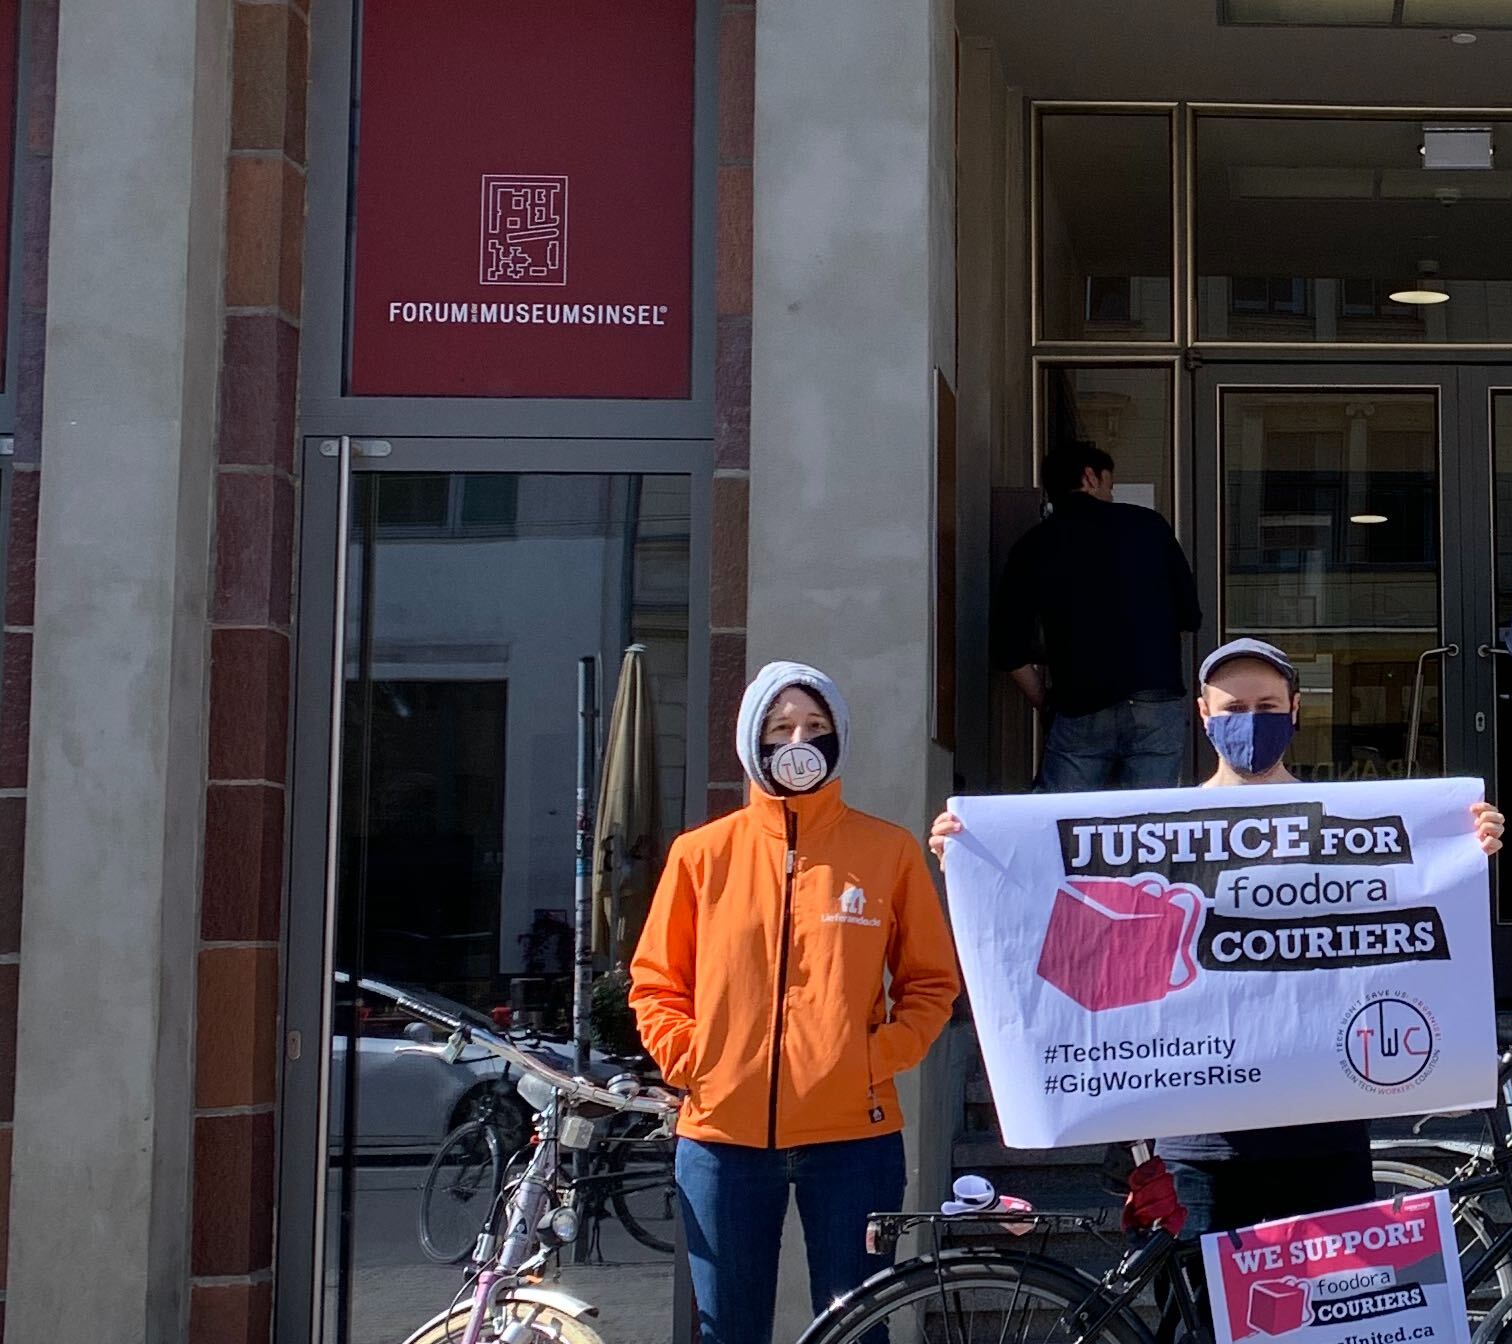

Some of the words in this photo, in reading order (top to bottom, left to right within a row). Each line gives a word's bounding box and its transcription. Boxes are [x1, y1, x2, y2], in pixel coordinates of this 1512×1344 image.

[389, 302, 468, 323] FORUM
[1071, 816, 1309, 868] JUSTICE
[1320, 827, 1401, 856] FOR
[1227, 872, 1388, 909] foodora
[1211, 920, 1435, 963] COURIERS
[1044, 1035, 1236, 1065] #TechSolidarity
[1356, 1002, 1429, 1080] TWC
[1044, 1065, 1262, 1097] #GigWorkersRise
[1358, 1081, 1377, 1094] TECH
[1232, 1247, 1283, 1275] WE
[1289, 1219, 1425, 1266] SUPPORT
[1317, 1268, 1391, 1296] foodora
[1317, 1288, 1422, 1322] COURIERS
